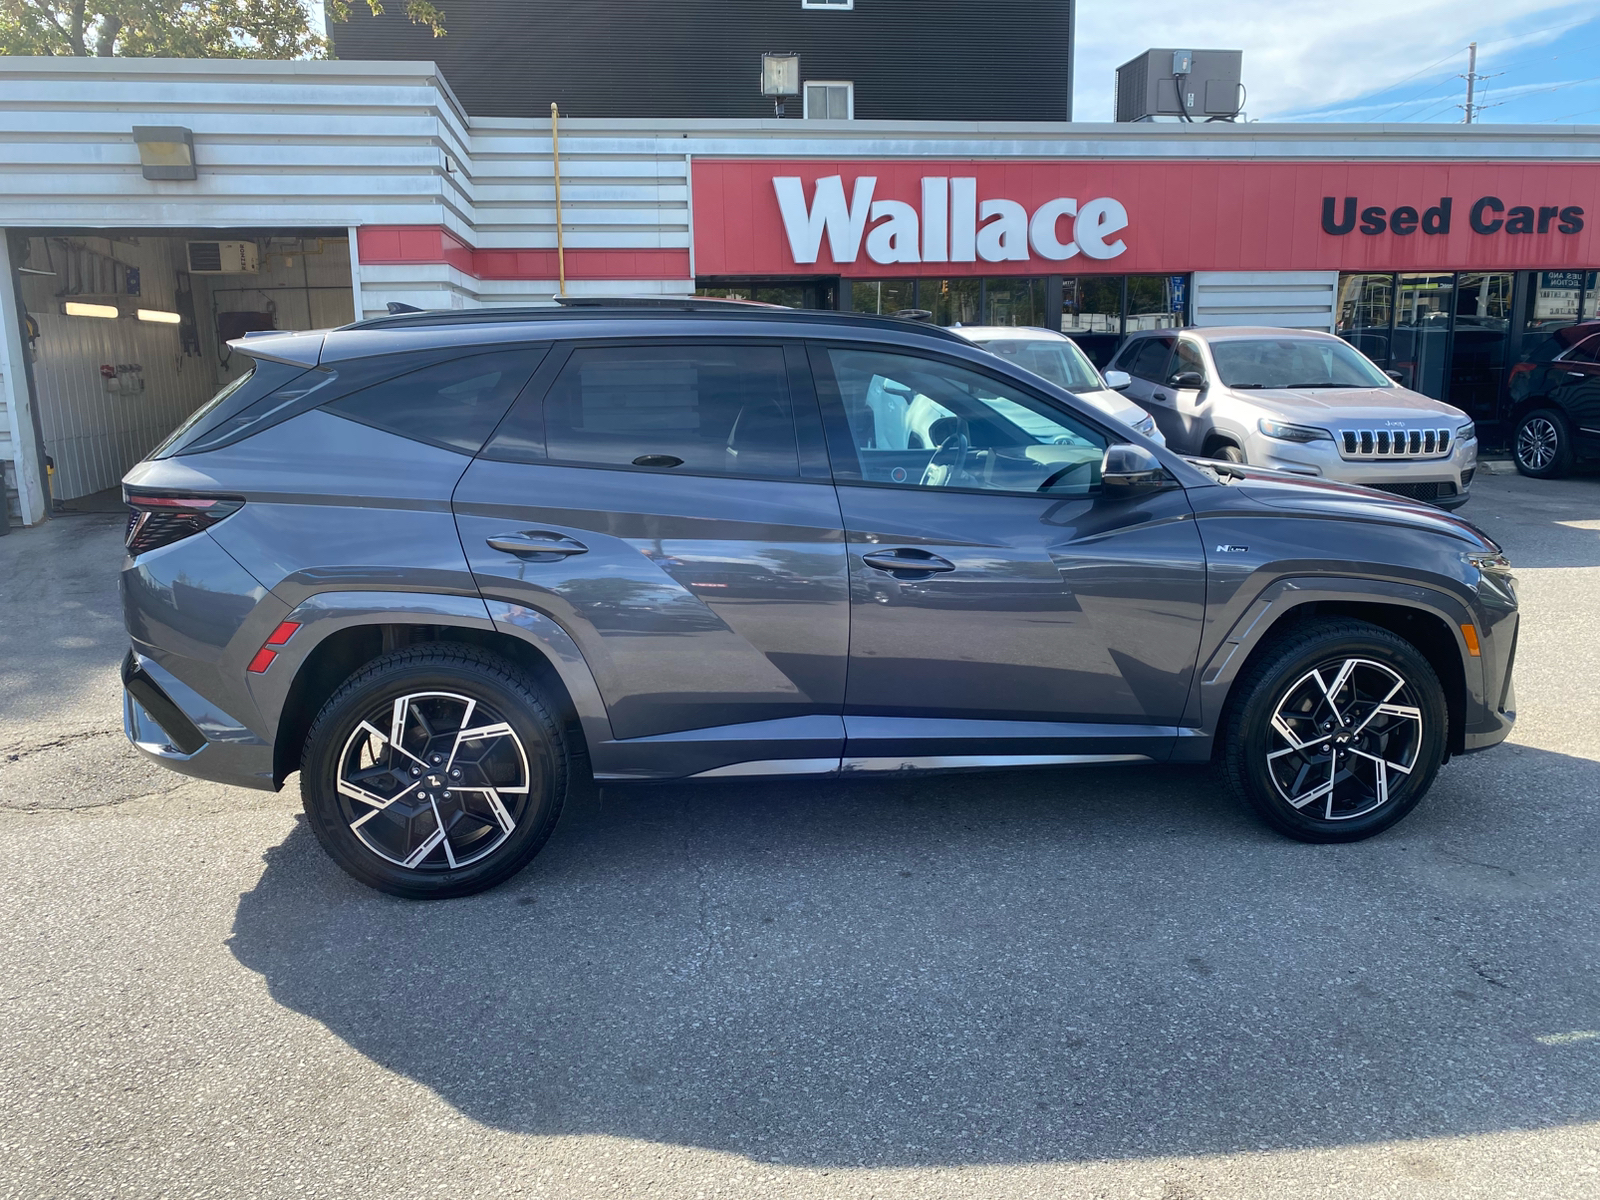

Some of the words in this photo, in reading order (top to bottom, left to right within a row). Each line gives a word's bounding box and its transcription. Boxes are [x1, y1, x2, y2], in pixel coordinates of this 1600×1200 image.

[771, 174, 1129, 264] Wallace
[1321, 195, 1453, 236] Used
[1469, 195, 1585, 236] Cars
[1384, 420, 1406, 428] Jeep
